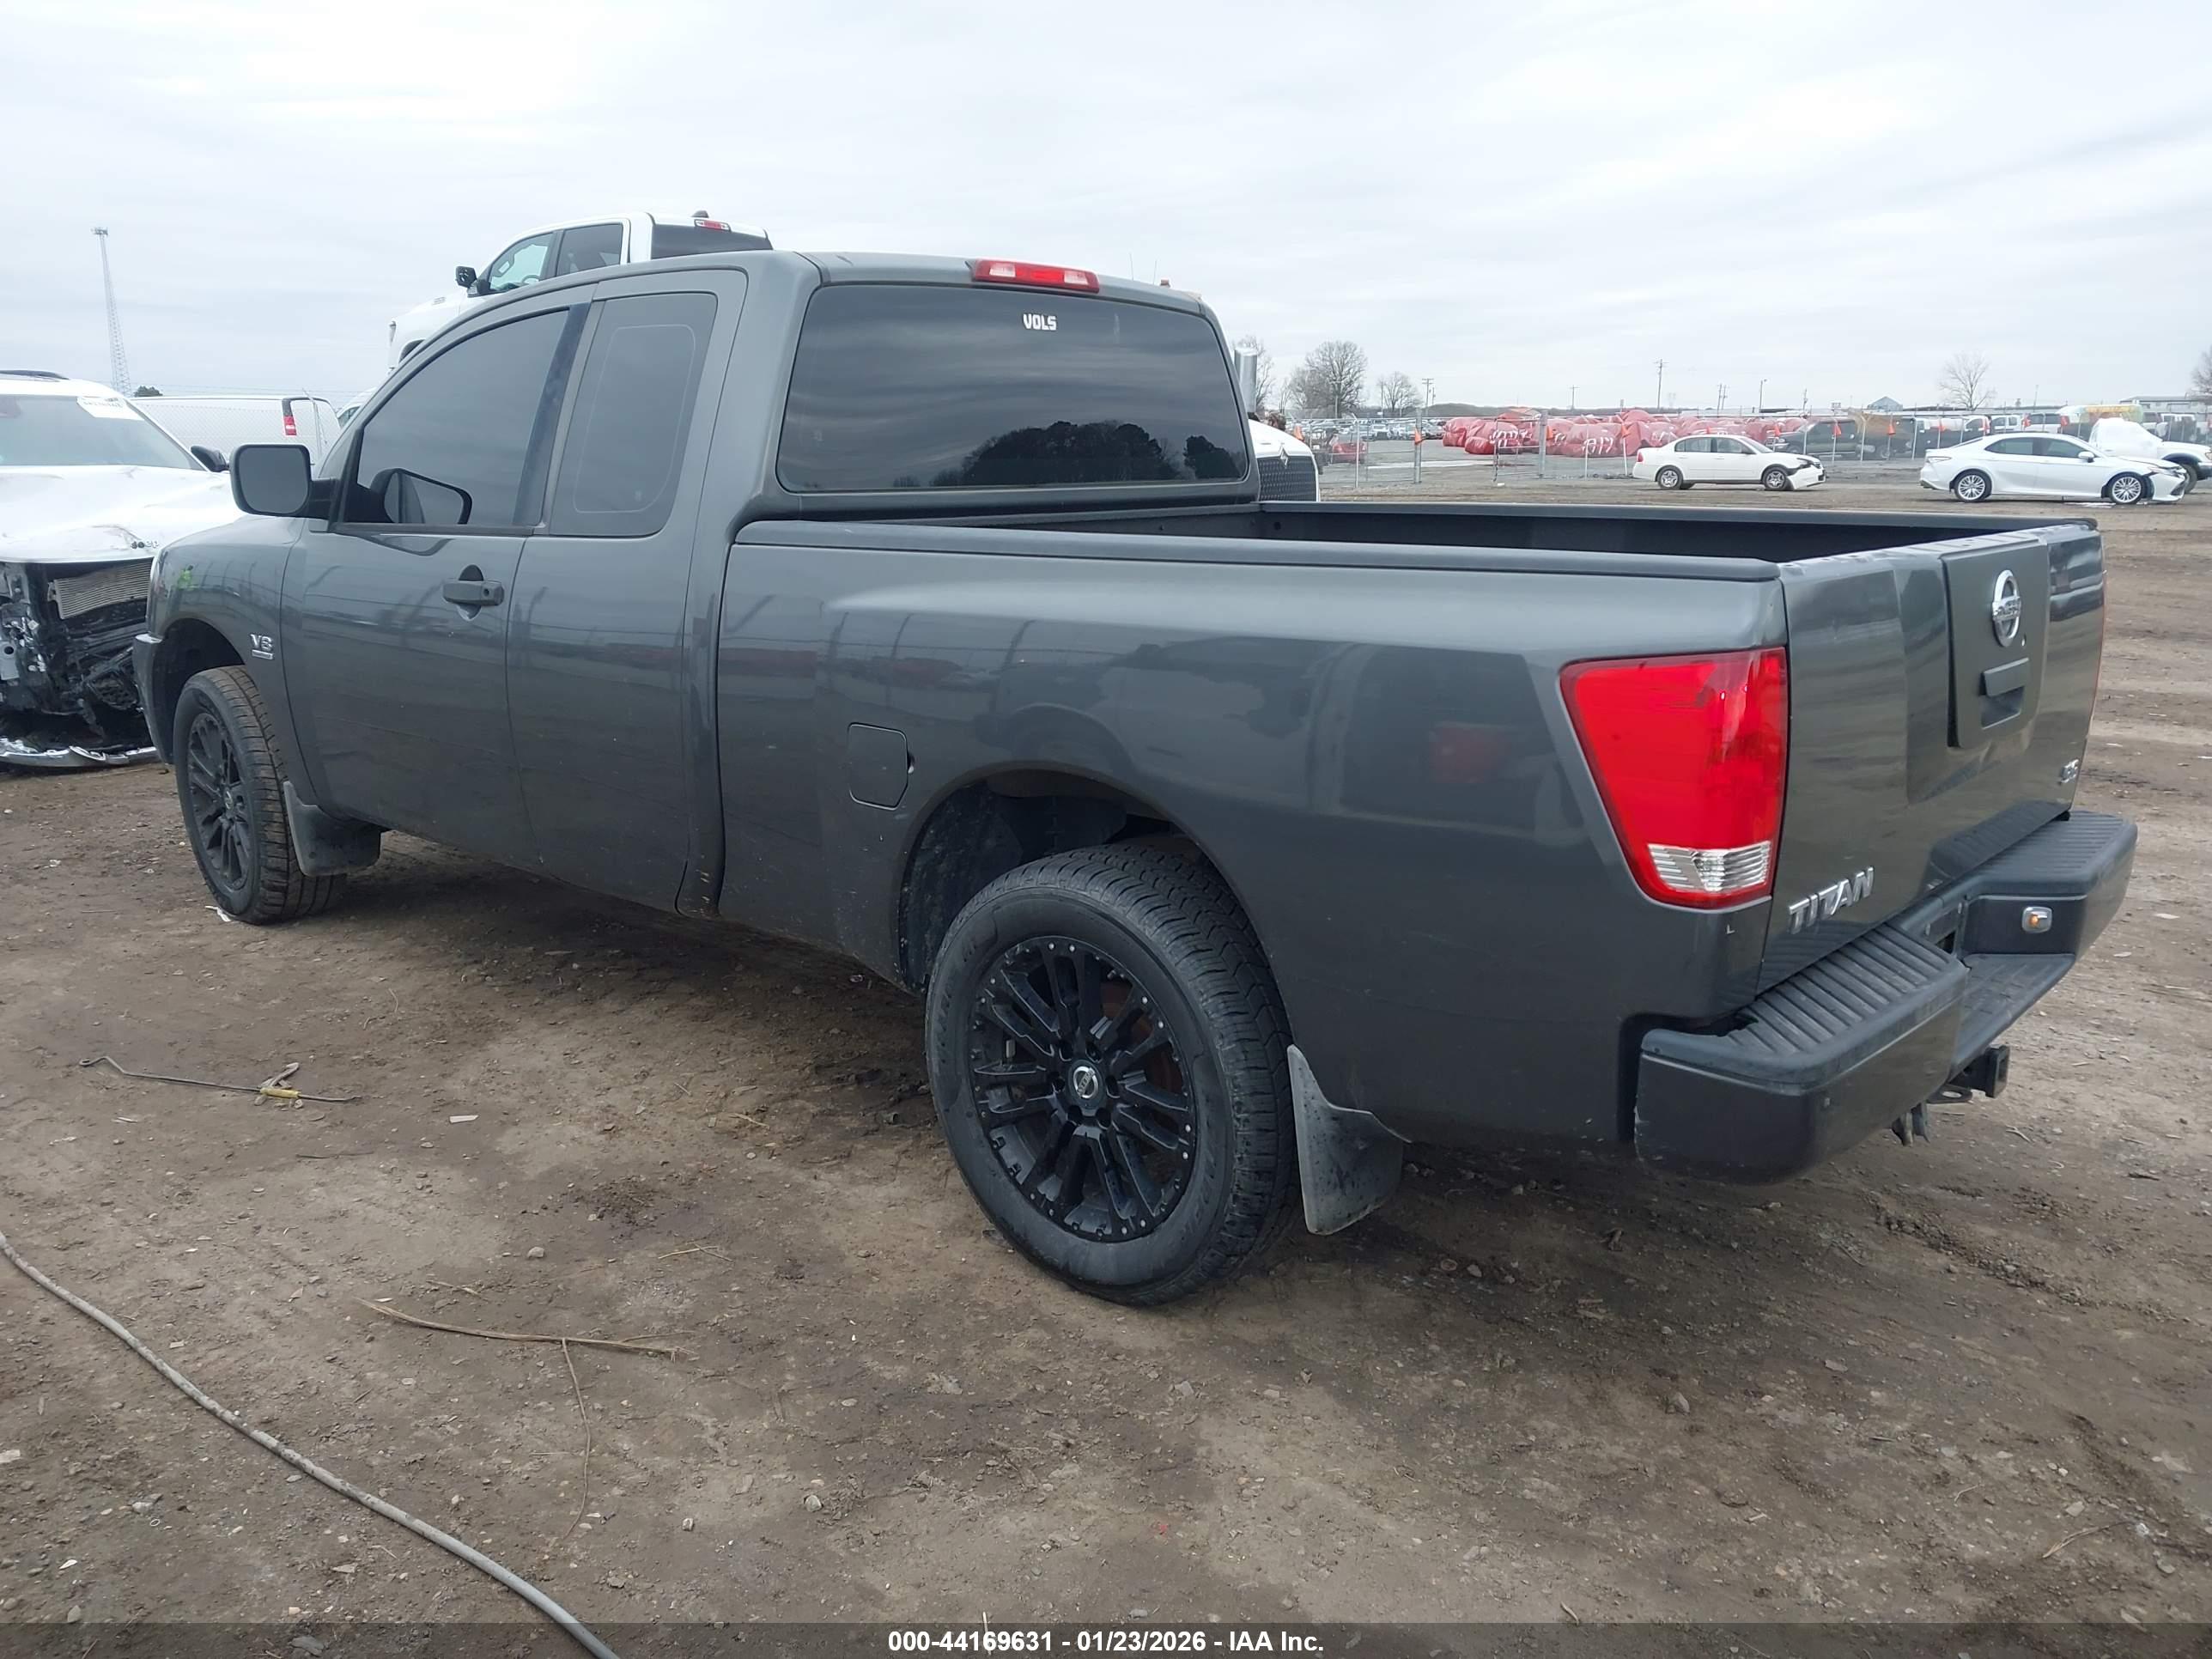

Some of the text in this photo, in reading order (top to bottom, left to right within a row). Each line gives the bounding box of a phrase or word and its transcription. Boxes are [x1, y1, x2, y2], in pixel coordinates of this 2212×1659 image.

[1023, 313, 1057, 331] VOLS
[250, 633, 273, 653] V8
[1788, 866, 1875, 935] TITAN
